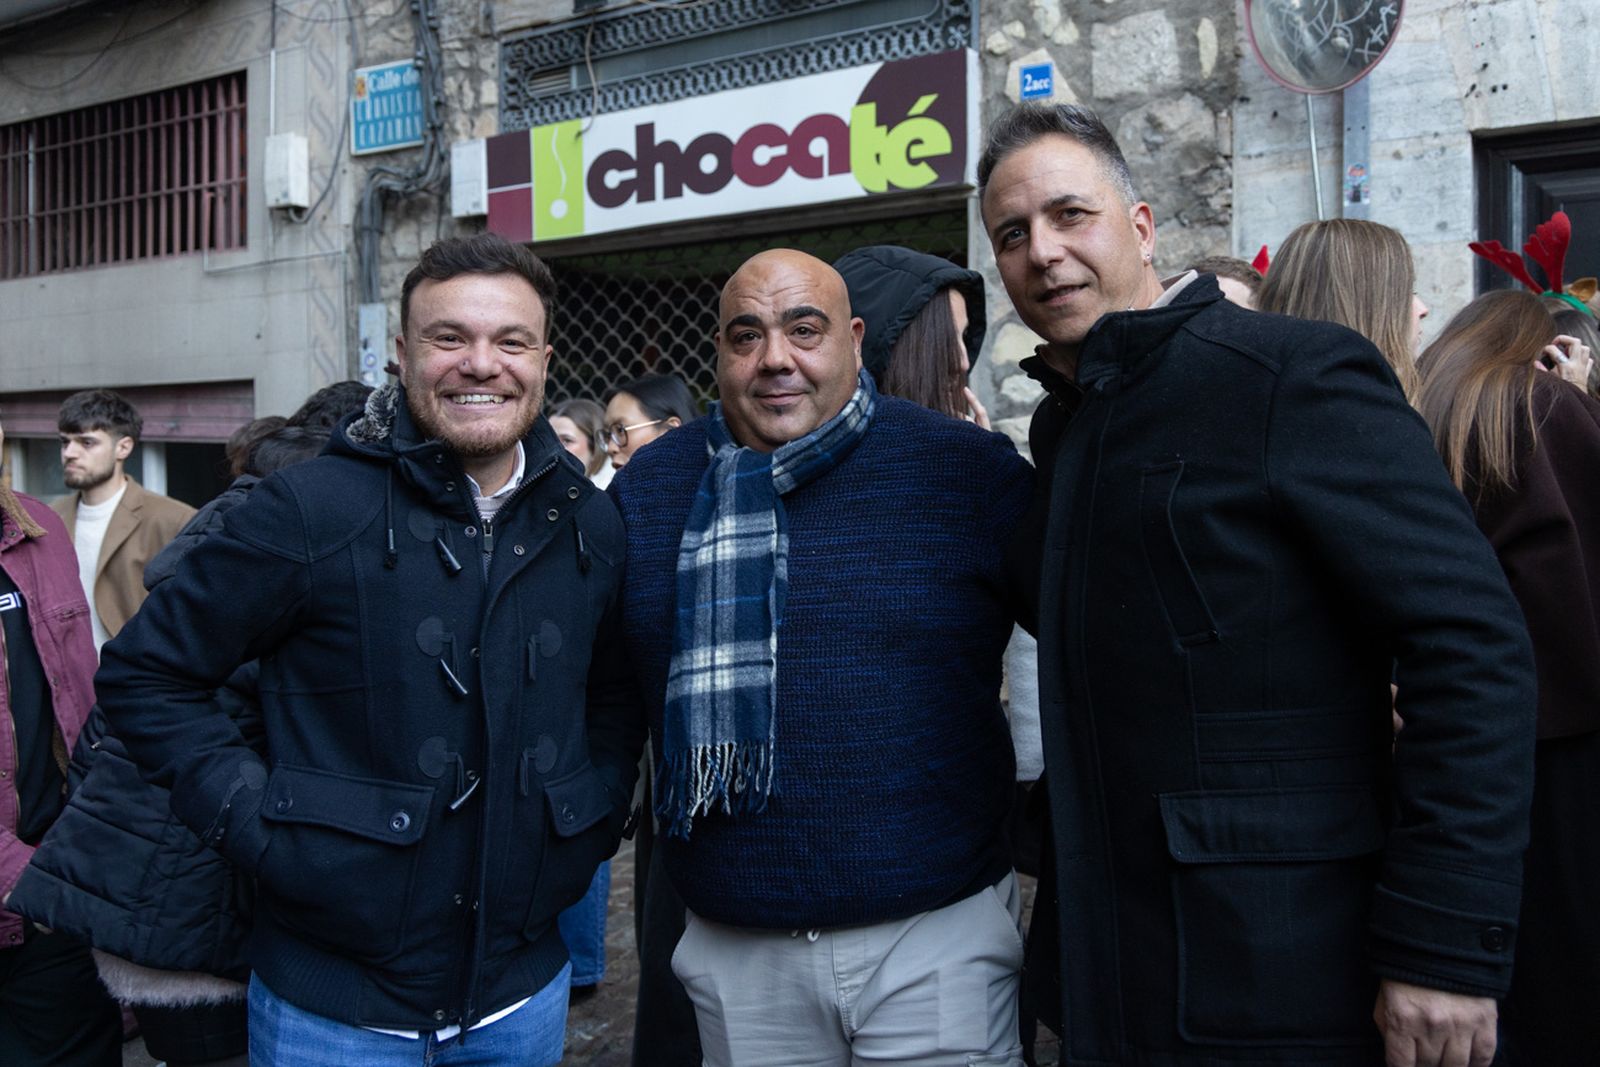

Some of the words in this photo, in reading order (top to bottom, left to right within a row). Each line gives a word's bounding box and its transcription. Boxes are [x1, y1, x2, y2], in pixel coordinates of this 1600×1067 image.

[368, 69, 401, 93] Calle
[402, 66, 421, 87] de
[356, 89, 422, 122] CRONISTA
[586, 93, 953, 209] chocaté
